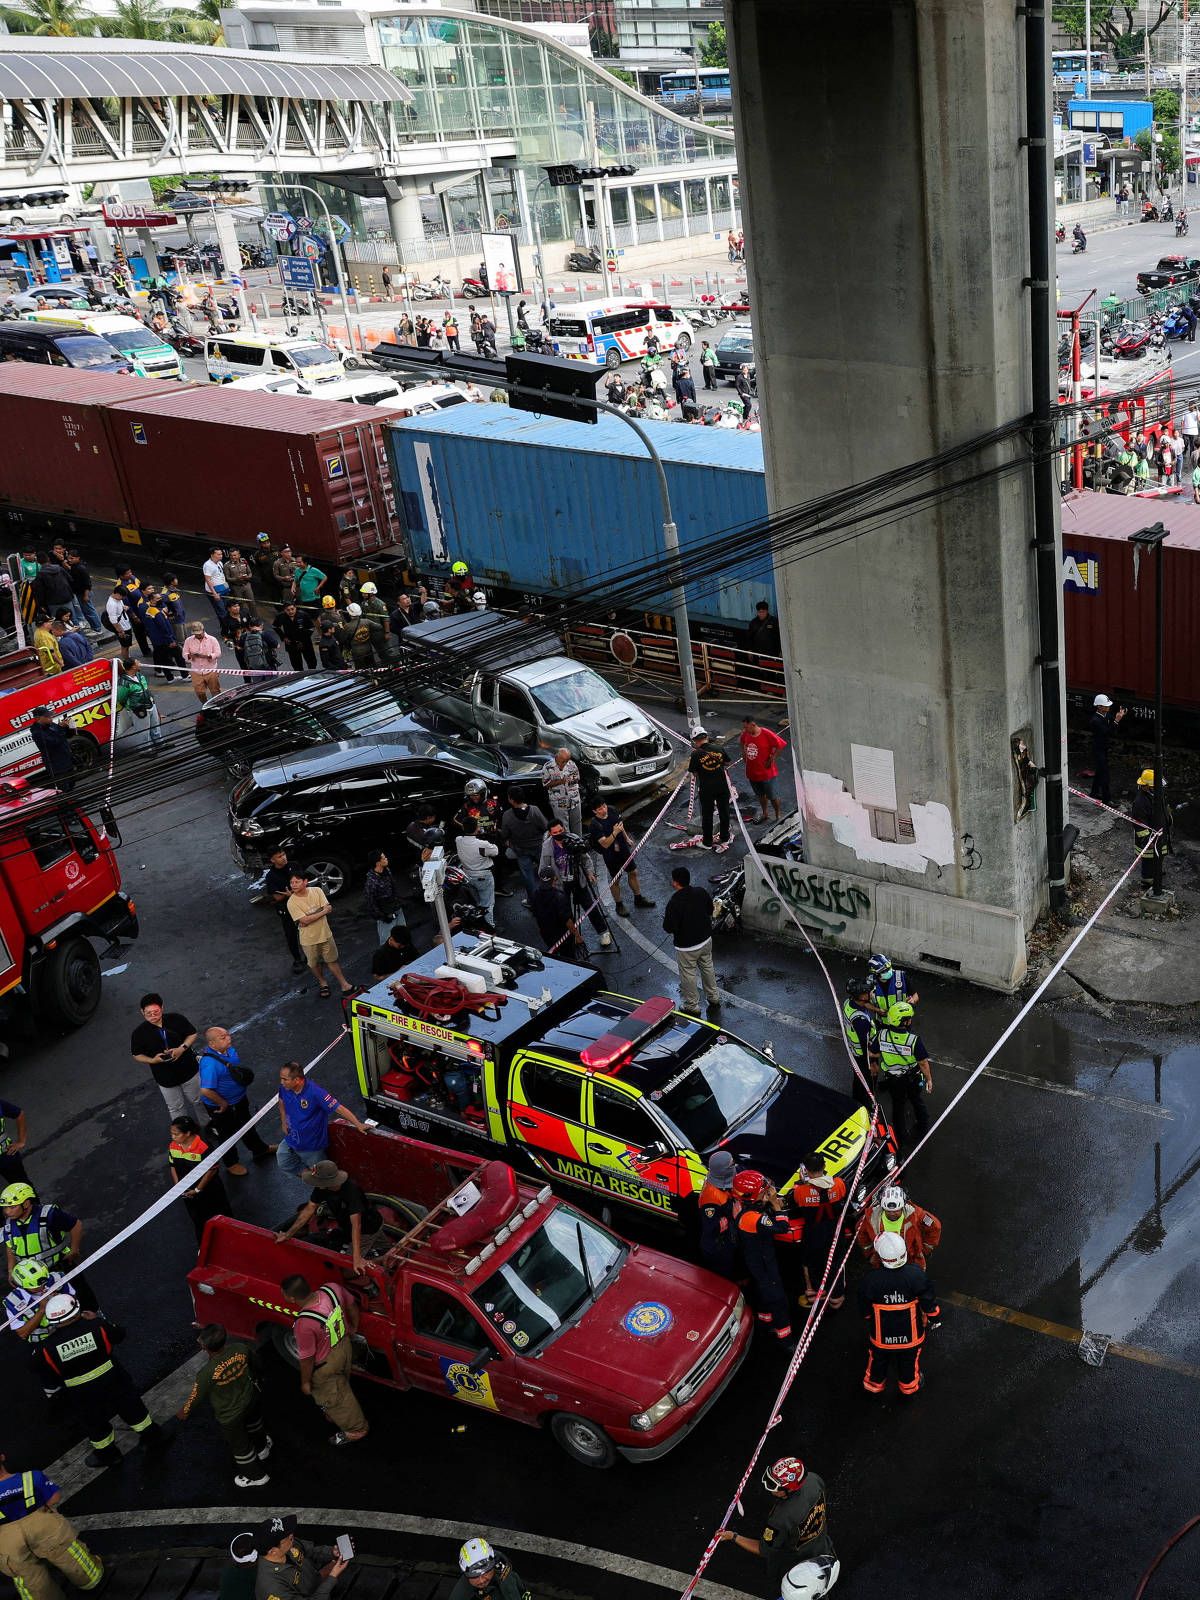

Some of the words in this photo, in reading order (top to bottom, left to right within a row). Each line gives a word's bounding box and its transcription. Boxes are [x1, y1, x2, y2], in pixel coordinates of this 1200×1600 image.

[391, 1014, 409, 1027] FIRE
[412, 1021, 418, 1030] &
[420, 1024, 454, 1041] RESCUE
[820, 1126, 863, 1164] IRE
[556, 1157, 606, 1188] MRTA
[609, 1175, 672, 1211] RESCUE
[884, 1335, 909, 1344] MRTA
